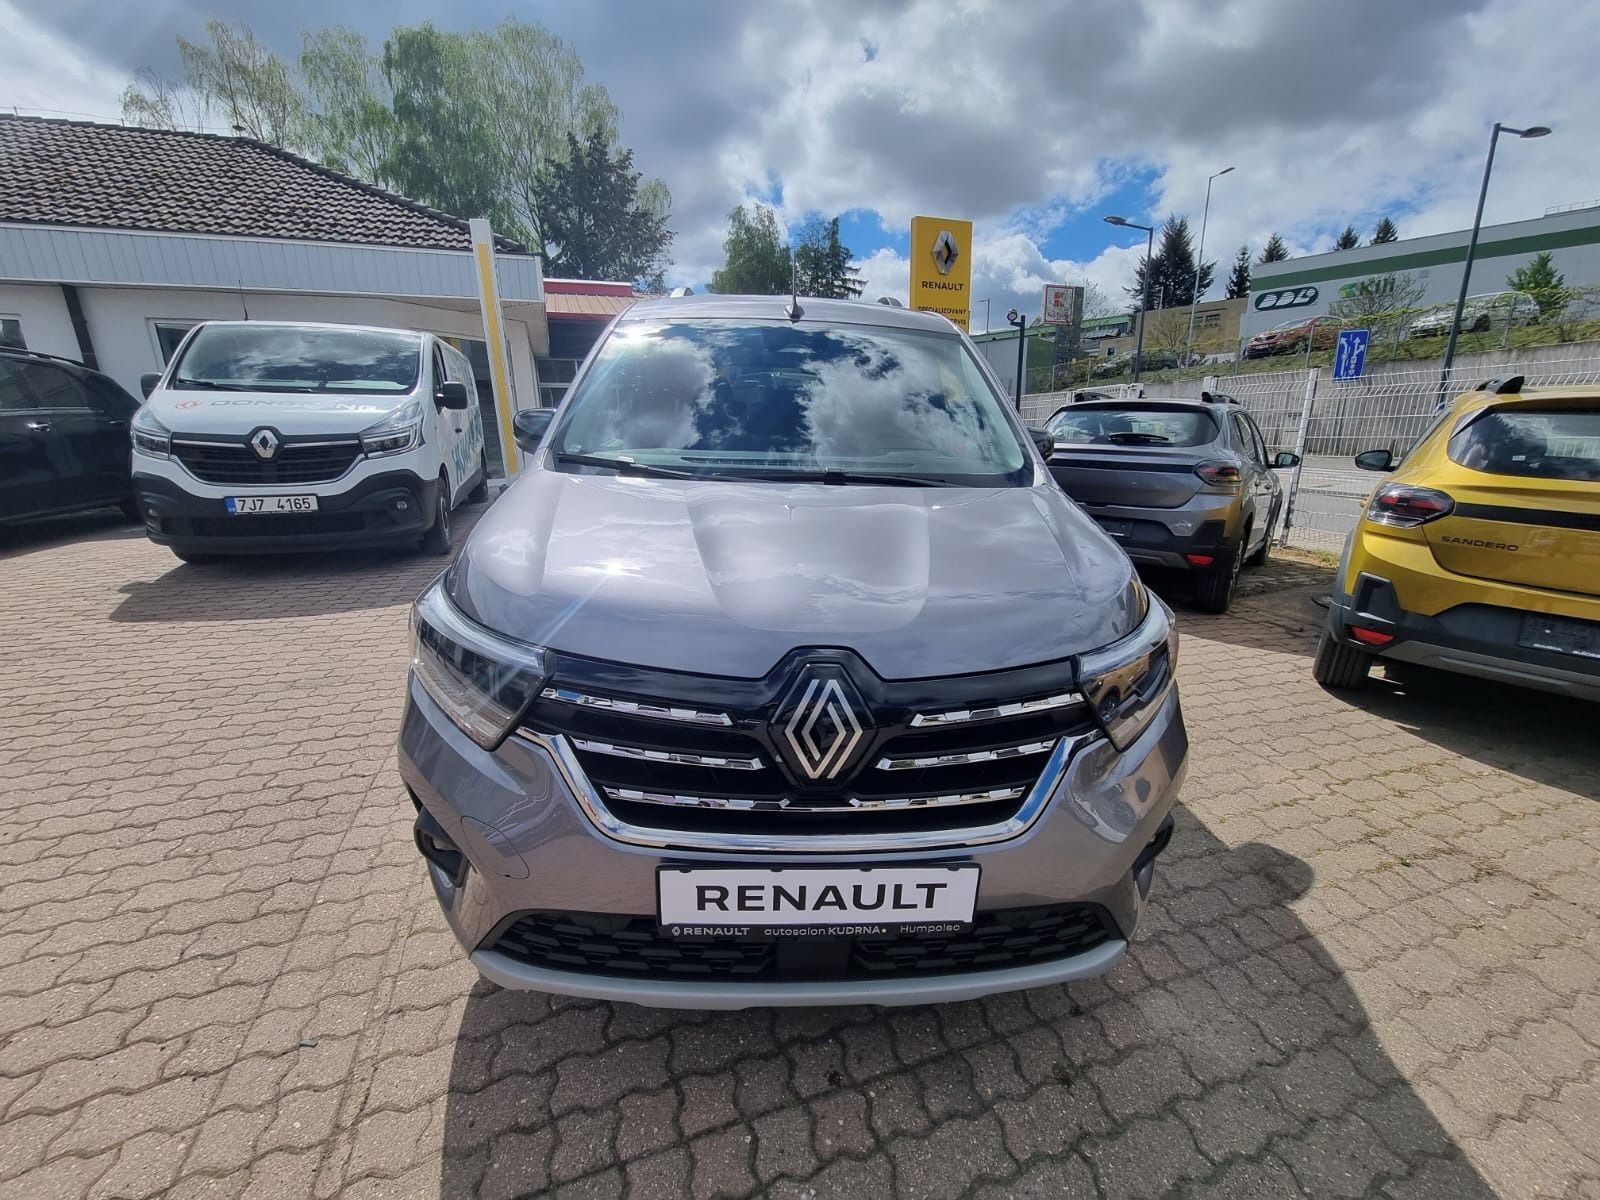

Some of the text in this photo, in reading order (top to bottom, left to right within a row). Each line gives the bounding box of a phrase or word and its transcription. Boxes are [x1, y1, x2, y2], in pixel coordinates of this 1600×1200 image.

[921, 281, 964, 291] RENAULT
[238, 498, 264, 512] 7J7
[277, 497, 311, 510] 4165
[1440, 535, 1519, 552] SANDERO
[696, 883, 947, 911] RENAULT
[683, 924, 960, 936] RENAULT autosalon KUDRNA Humpolec
